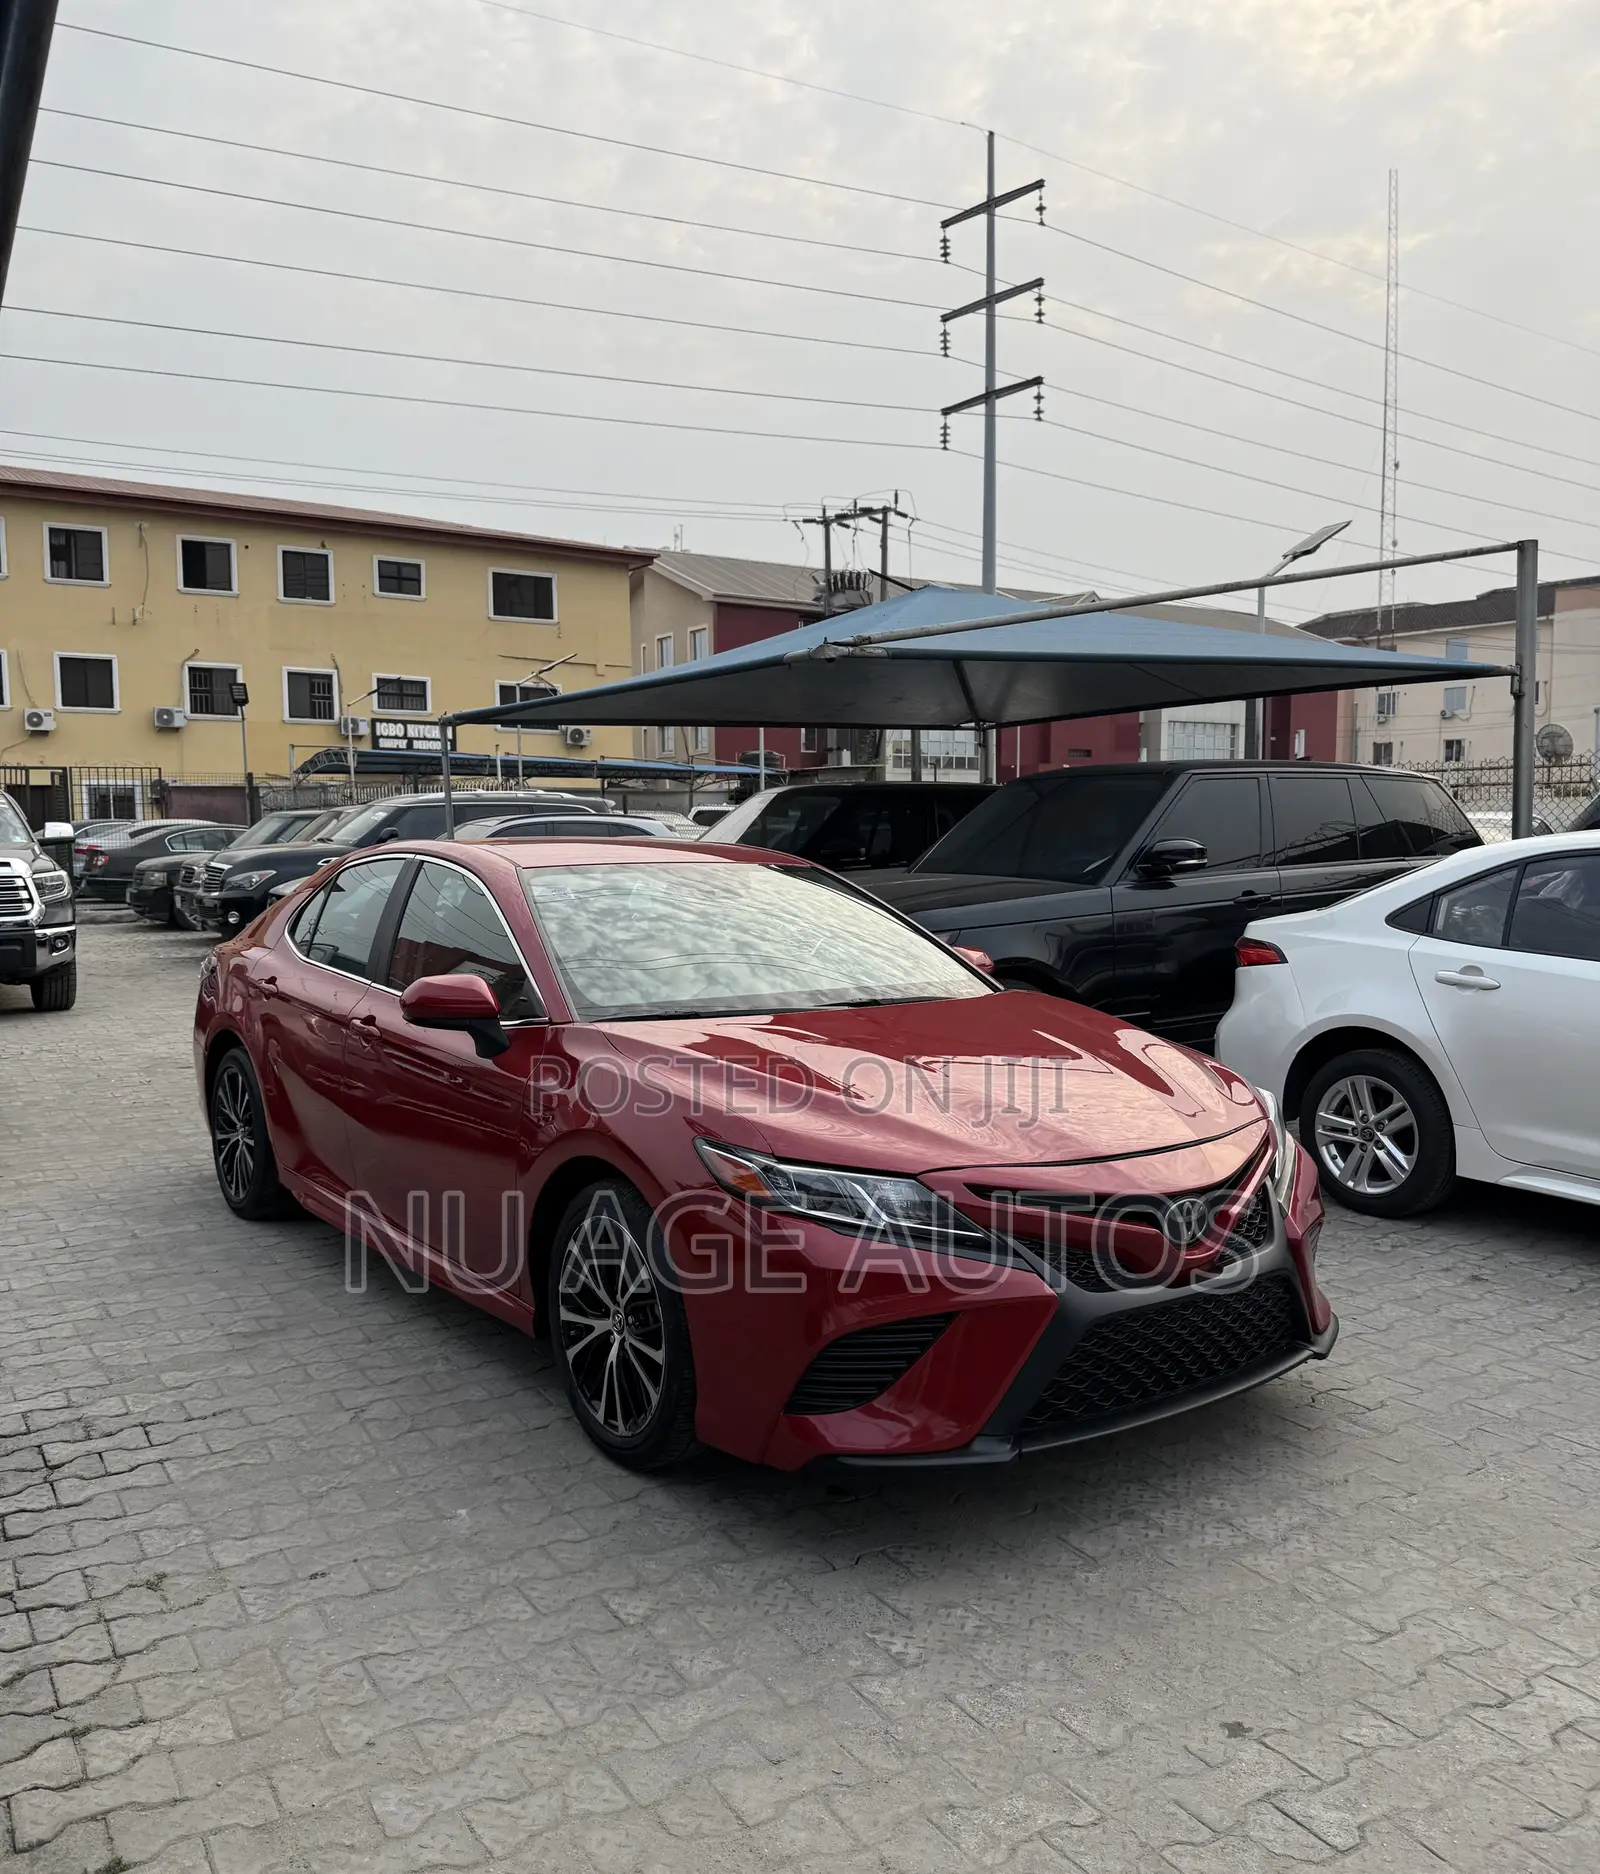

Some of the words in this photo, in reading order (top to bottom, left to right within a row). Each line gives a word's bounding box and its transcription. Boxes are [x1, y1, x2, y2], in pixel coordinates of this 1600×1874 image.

[375, 721, 404, 736] IGBO
[406, 723, 453, 739] KITCHN
[379, 738, 408, 748] SIMPLY
[413, 739, 451, 750] DELICIOS
